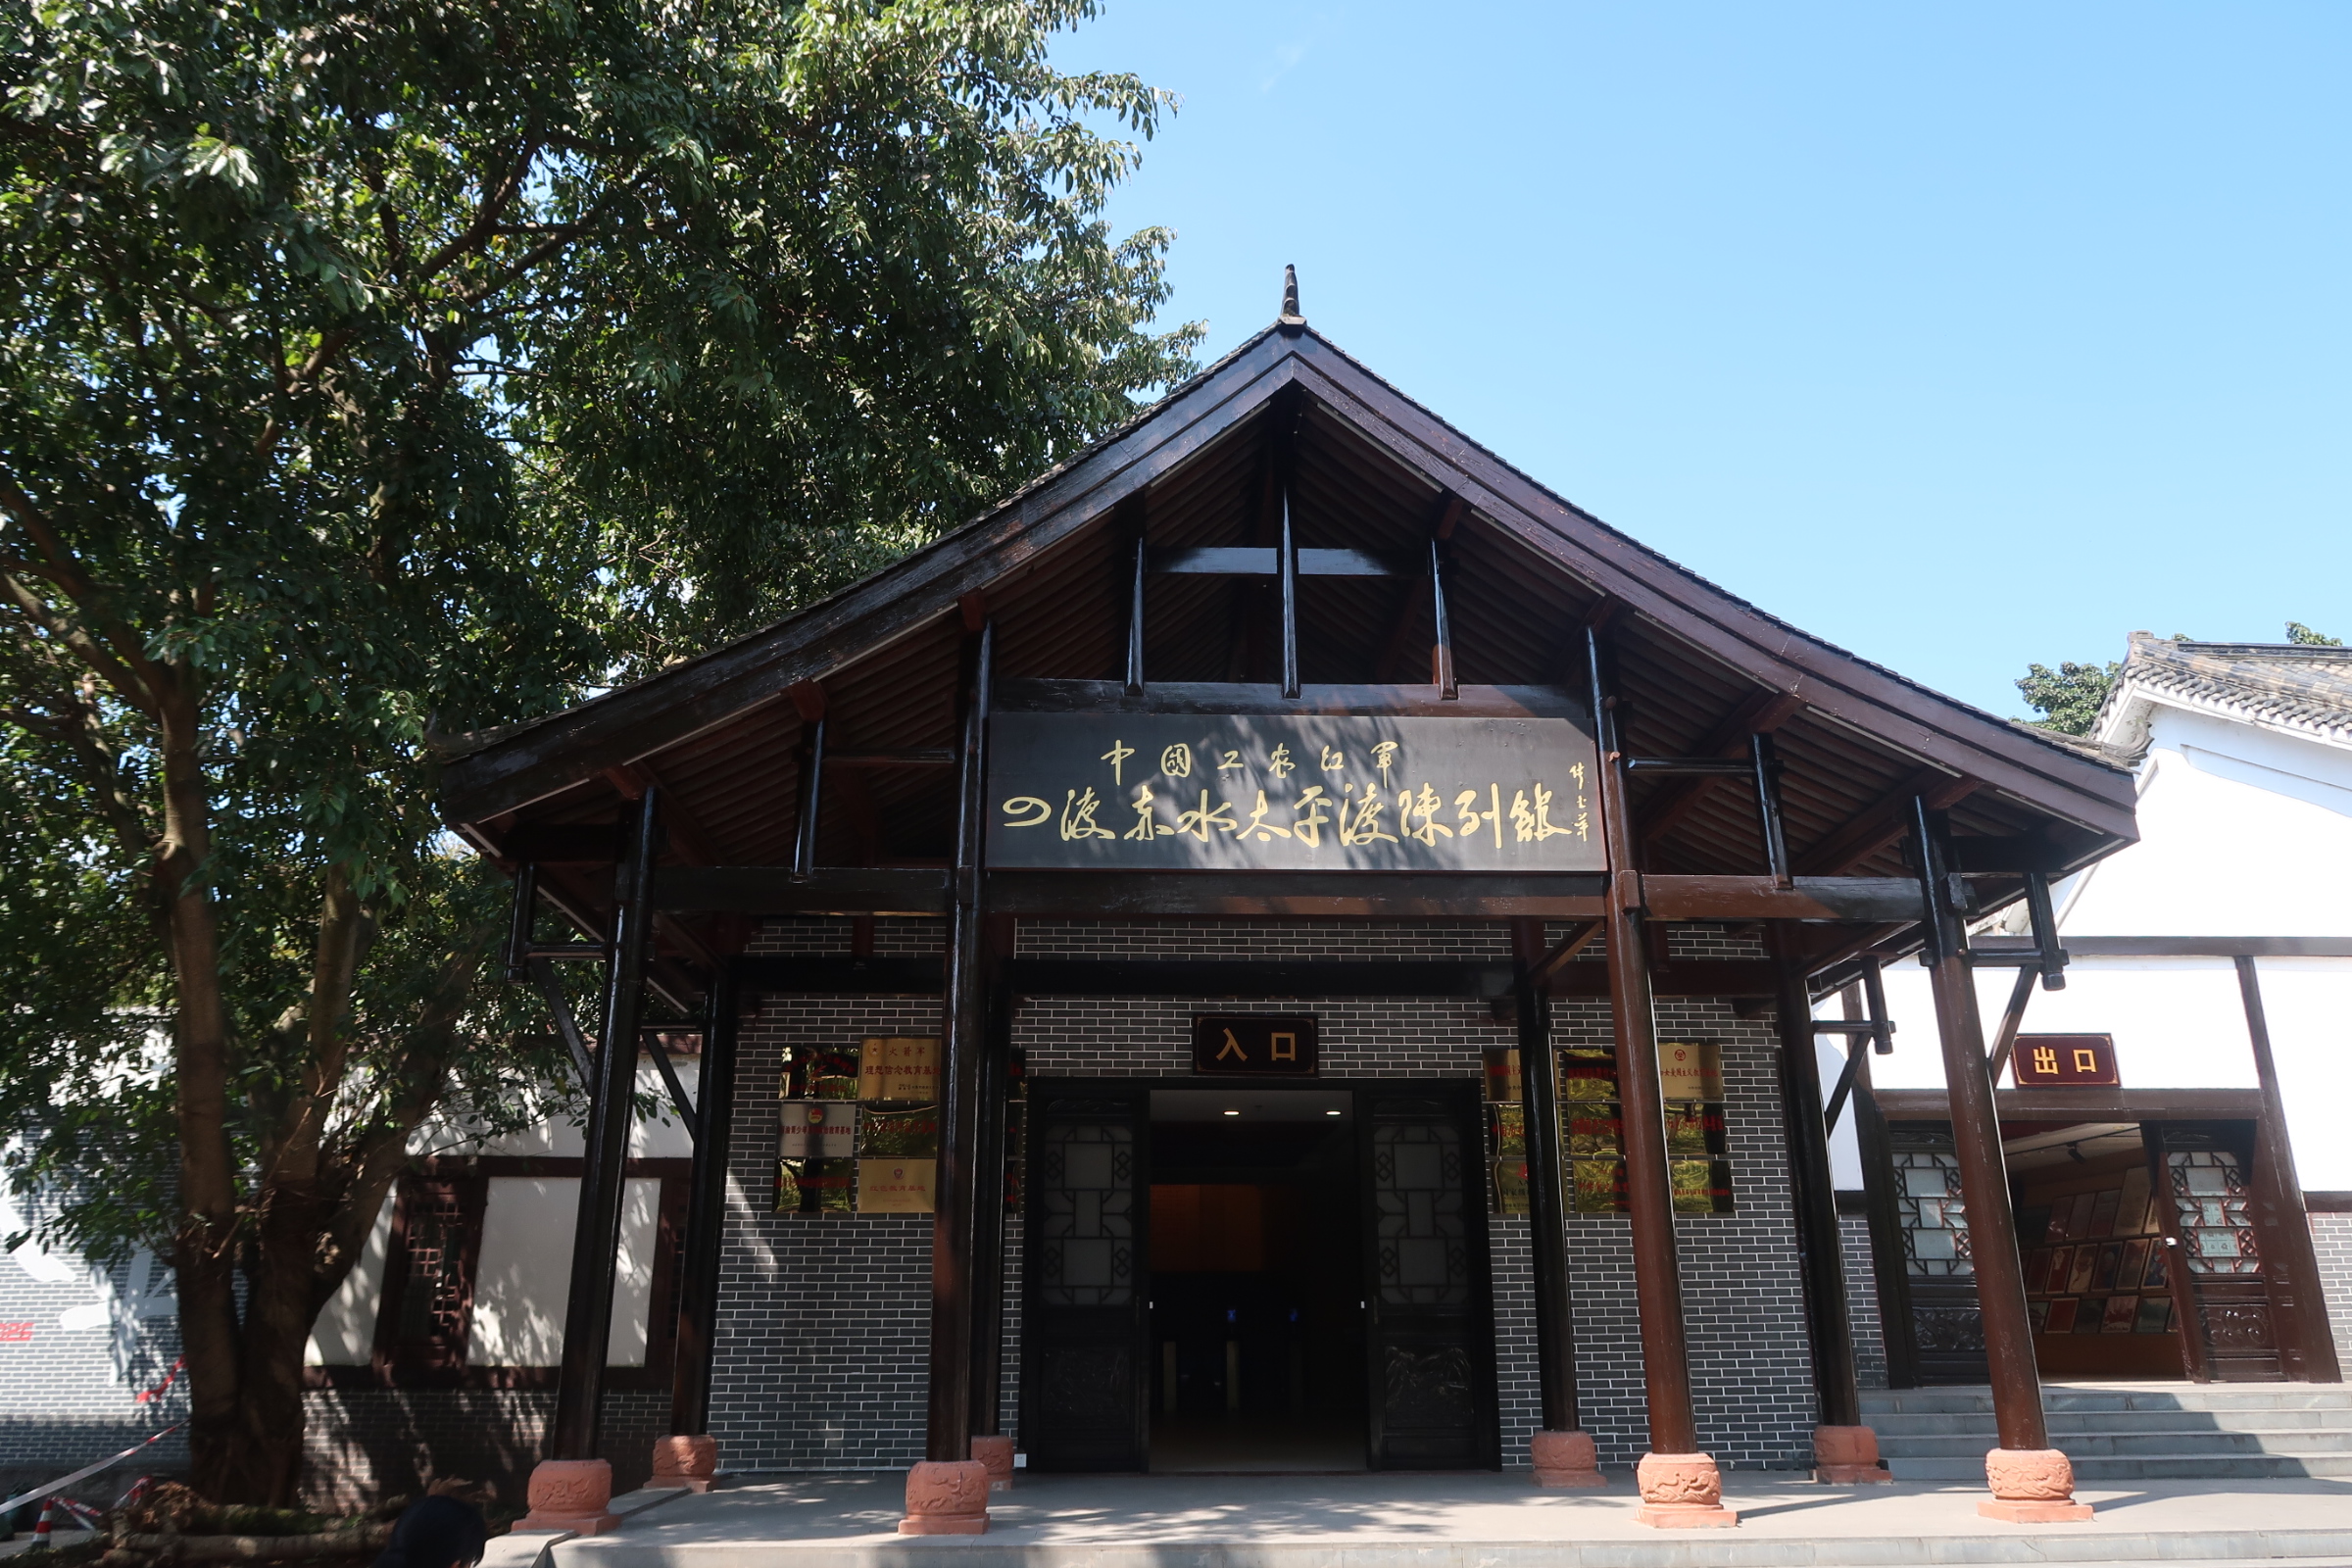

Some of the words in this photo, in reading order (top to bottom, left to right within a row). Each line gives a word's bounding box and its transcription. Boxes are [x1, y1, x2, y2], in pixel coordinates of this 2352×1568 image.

[888, 1045, 926, 1057] 火箭军
[1215, 1027, 1296, 1062] 入口
[864, 1064, 942, 1076] 理想信念教育基地
[2032, 1046, 2097, 1075] 出口
